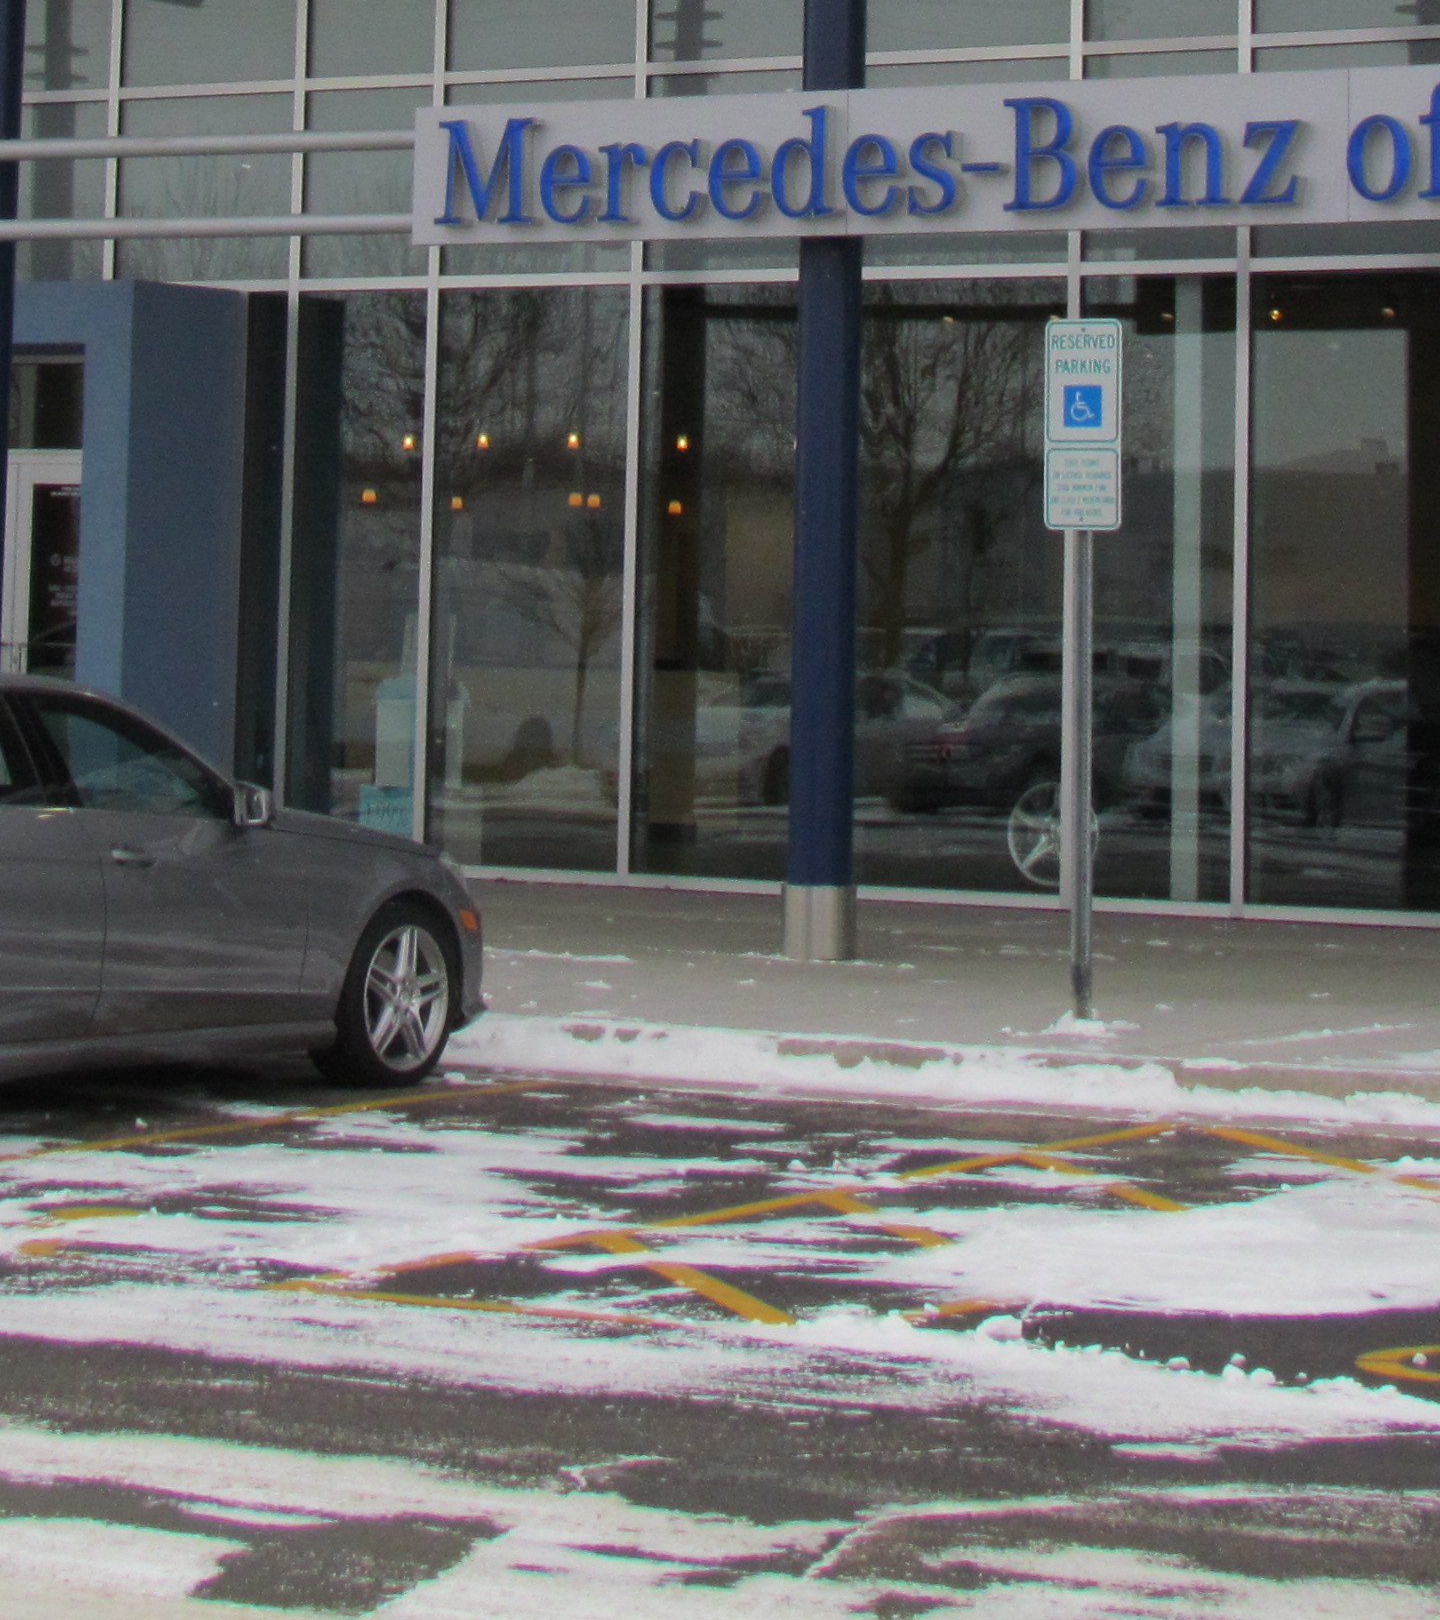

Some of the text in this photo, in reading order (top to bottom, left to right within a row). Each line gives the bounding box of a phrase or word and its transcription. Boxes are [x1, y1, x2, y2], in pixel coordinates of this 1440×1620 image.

[434, 96, 1302, 226] Mercedes-Benz
[1051, 333, 1116, 350] RESERVED
[1055, 358, 1112, 375] PARKING
